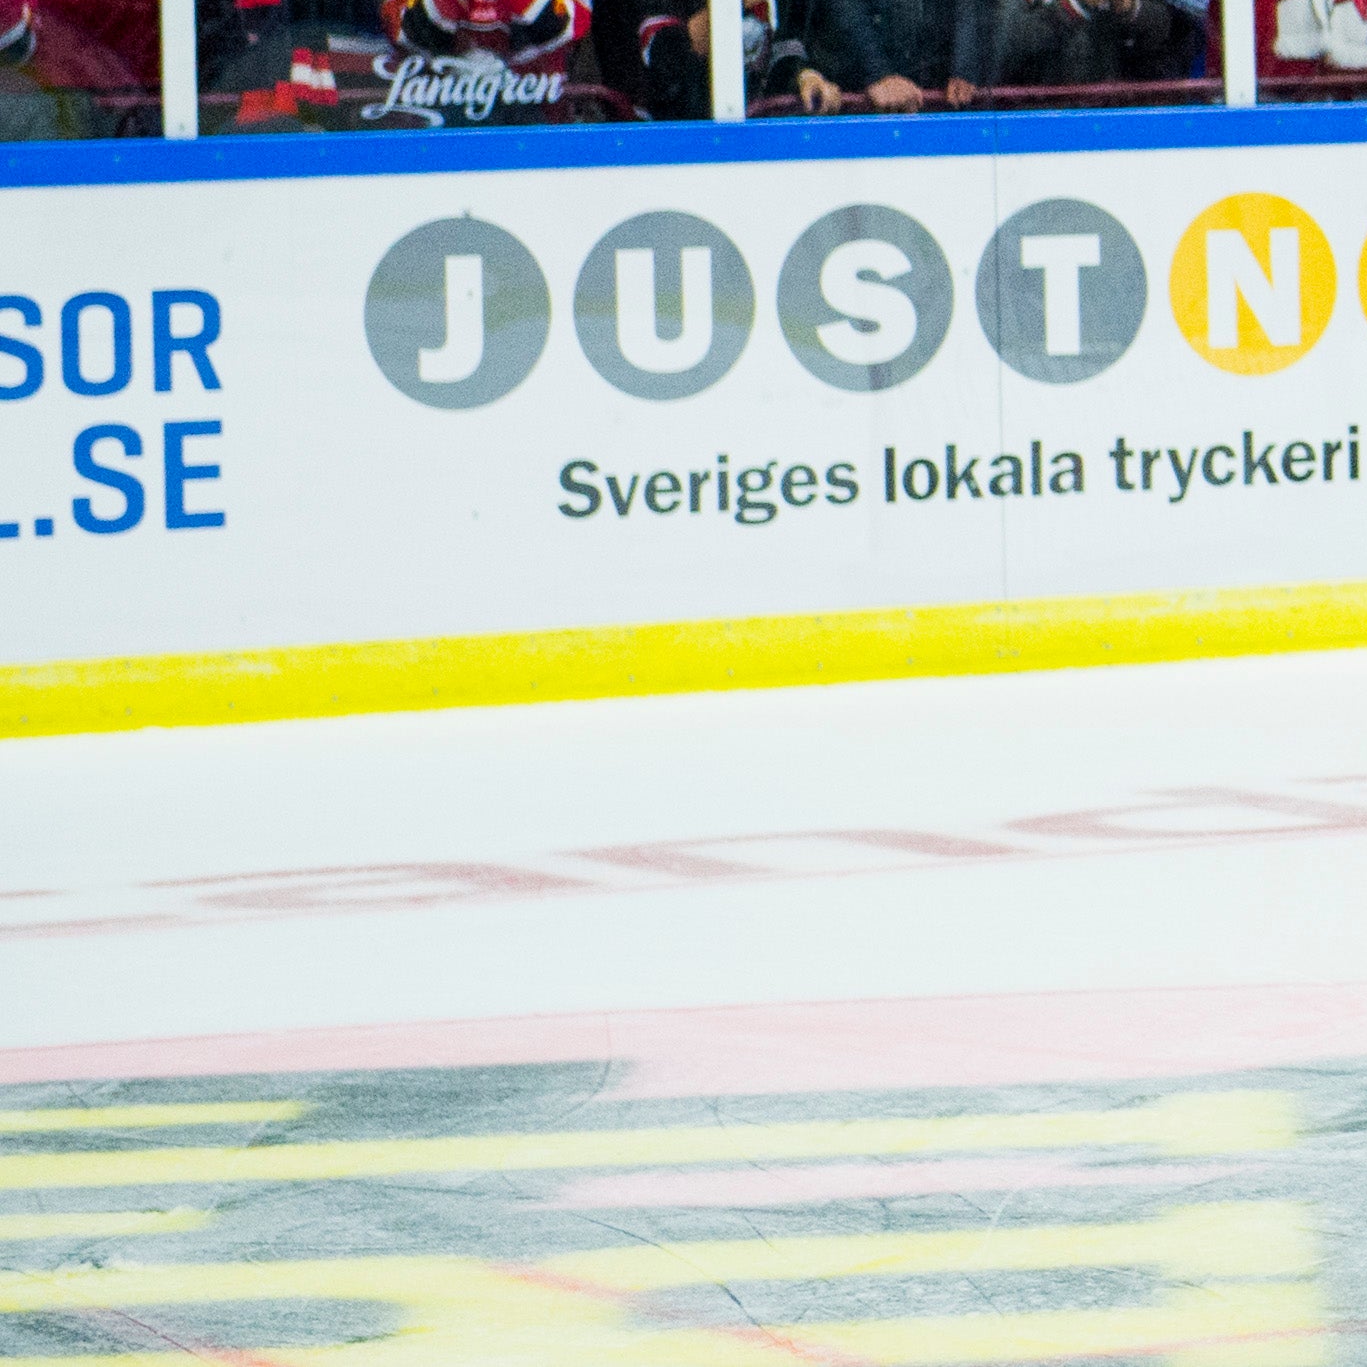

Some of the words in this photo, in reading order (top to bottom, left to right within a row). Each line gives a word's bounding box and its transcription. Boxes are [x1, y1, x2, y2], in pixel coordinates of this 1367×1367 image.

[361, 54, 566, 127] Landgren
[416, 230, 1102, 386] JUST
[0, 419, 227, 540] .SE
[557, 454, 860, 526] Sveriges
[883, 439, 1084, 502] lokala
[1110, 425, 1361, 503] tryckeri
